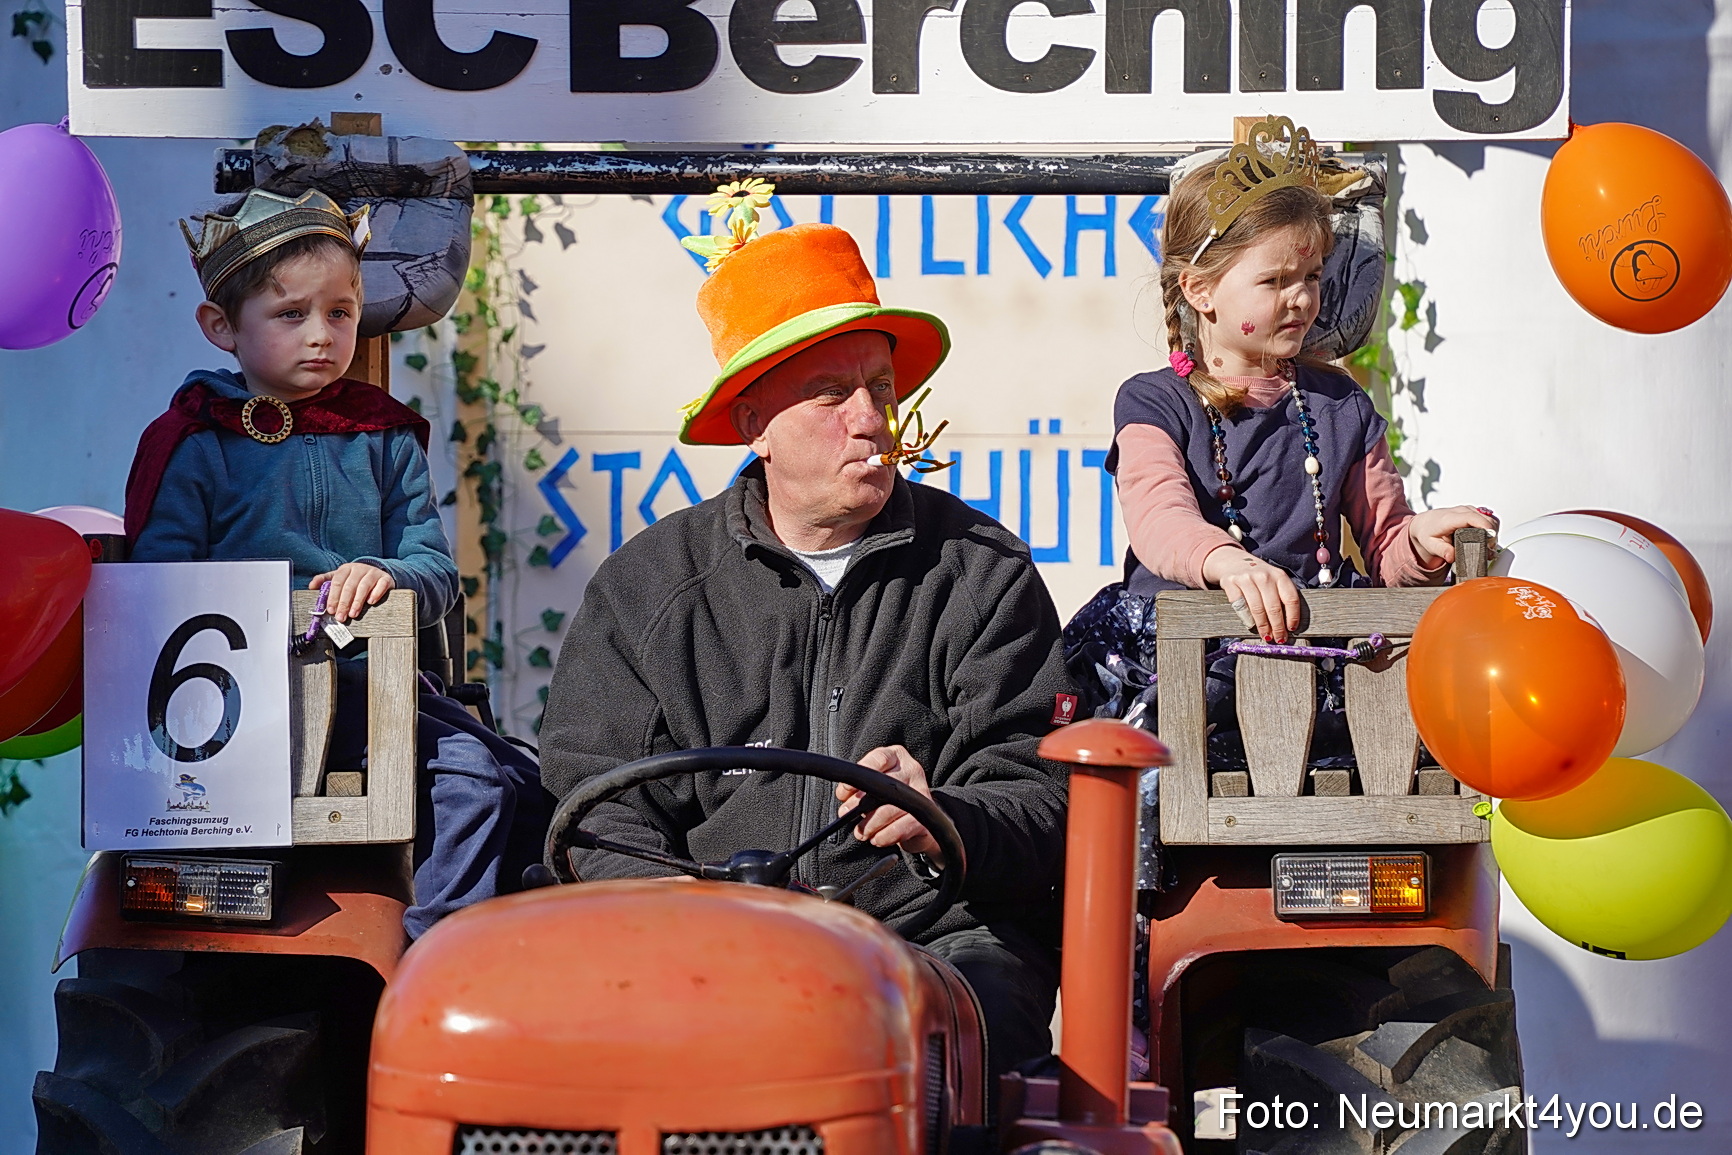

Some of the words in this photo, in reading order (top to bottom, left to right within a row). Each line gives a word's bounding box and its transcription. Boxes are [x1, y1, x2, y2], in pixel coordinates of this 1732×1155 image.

[1579, 195, 1667, 263] Lurchi
[147, 613, 248, 763] 6
[125, 828, 139, 838] FG
[141, 827, 188, 837] Hechtonia
[191, 826, 233, 837] Berching
[235, 825, 253, 834] e.V.
[149, 816, 229, 828] Faschingsumzug
